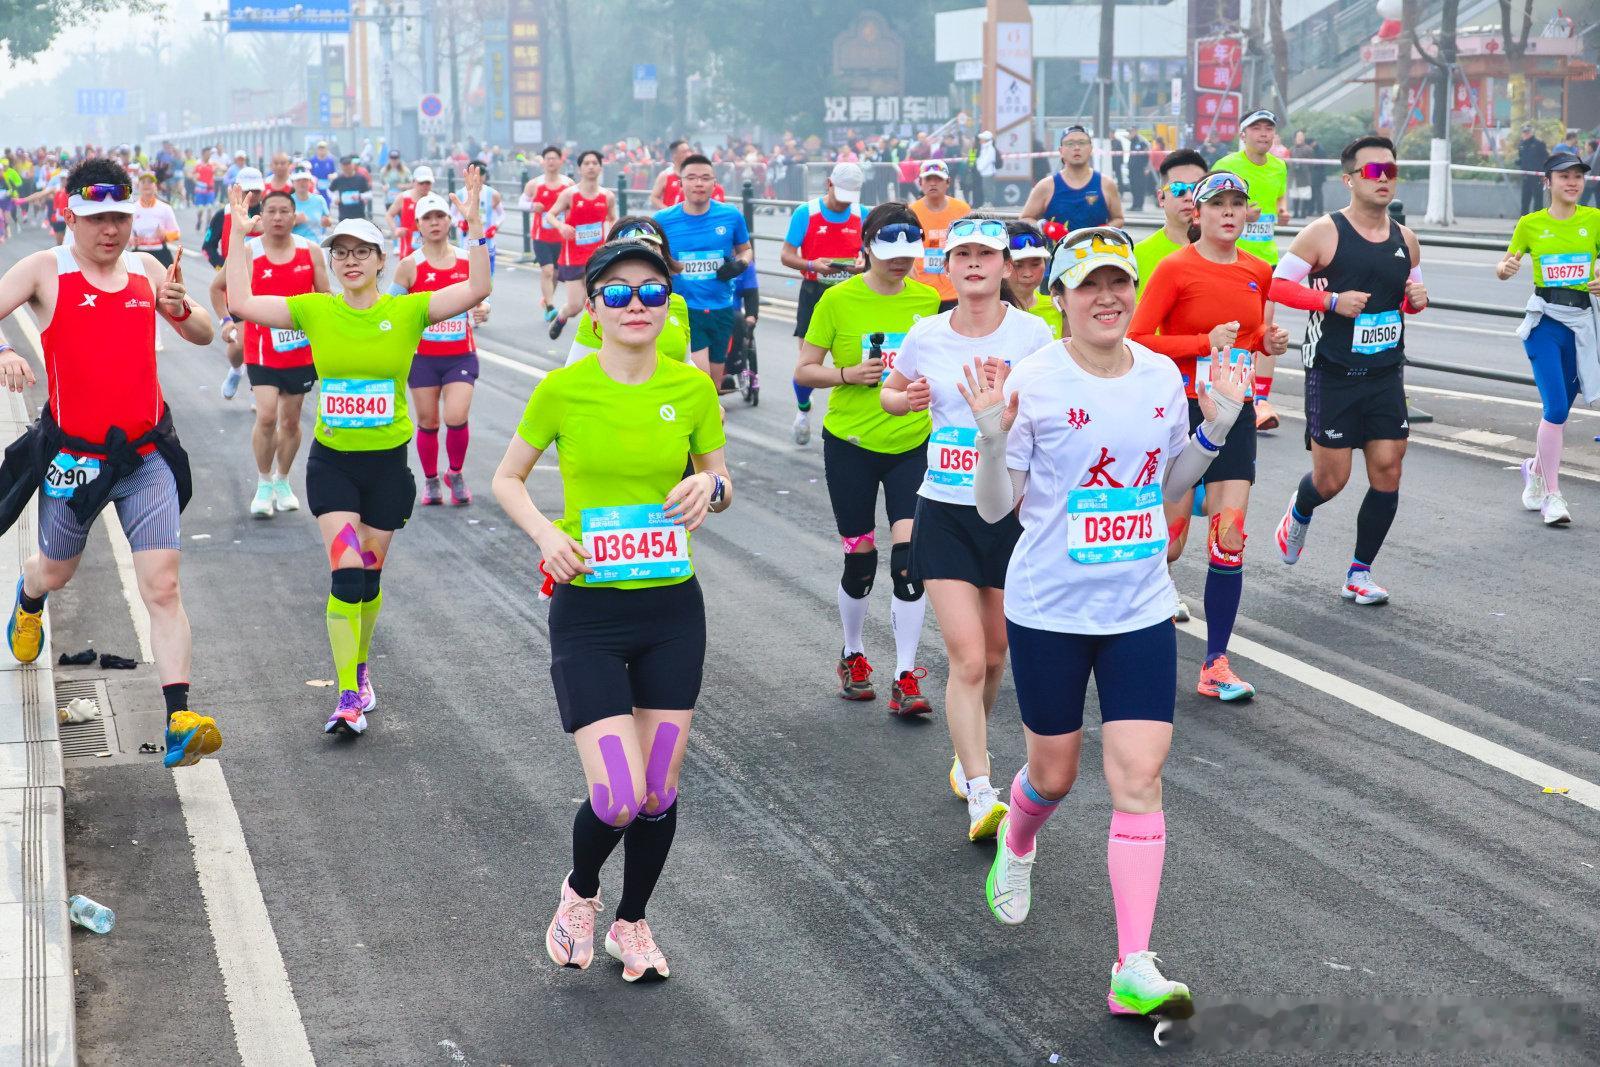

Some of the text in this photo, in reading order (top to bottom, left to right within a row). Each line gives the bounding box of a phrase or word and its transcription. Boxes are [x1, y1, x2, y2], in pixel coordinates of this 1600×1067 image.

[685, 261, 718, 273] D22130
[1547, 265, 1584, 279] D36775
[1361, 326, 1397, 343] D21506
[326, 396, 387, 414] D36840
[1085, 512, 1153, 543] D36713
[593, 531, 678, 562] D36454
